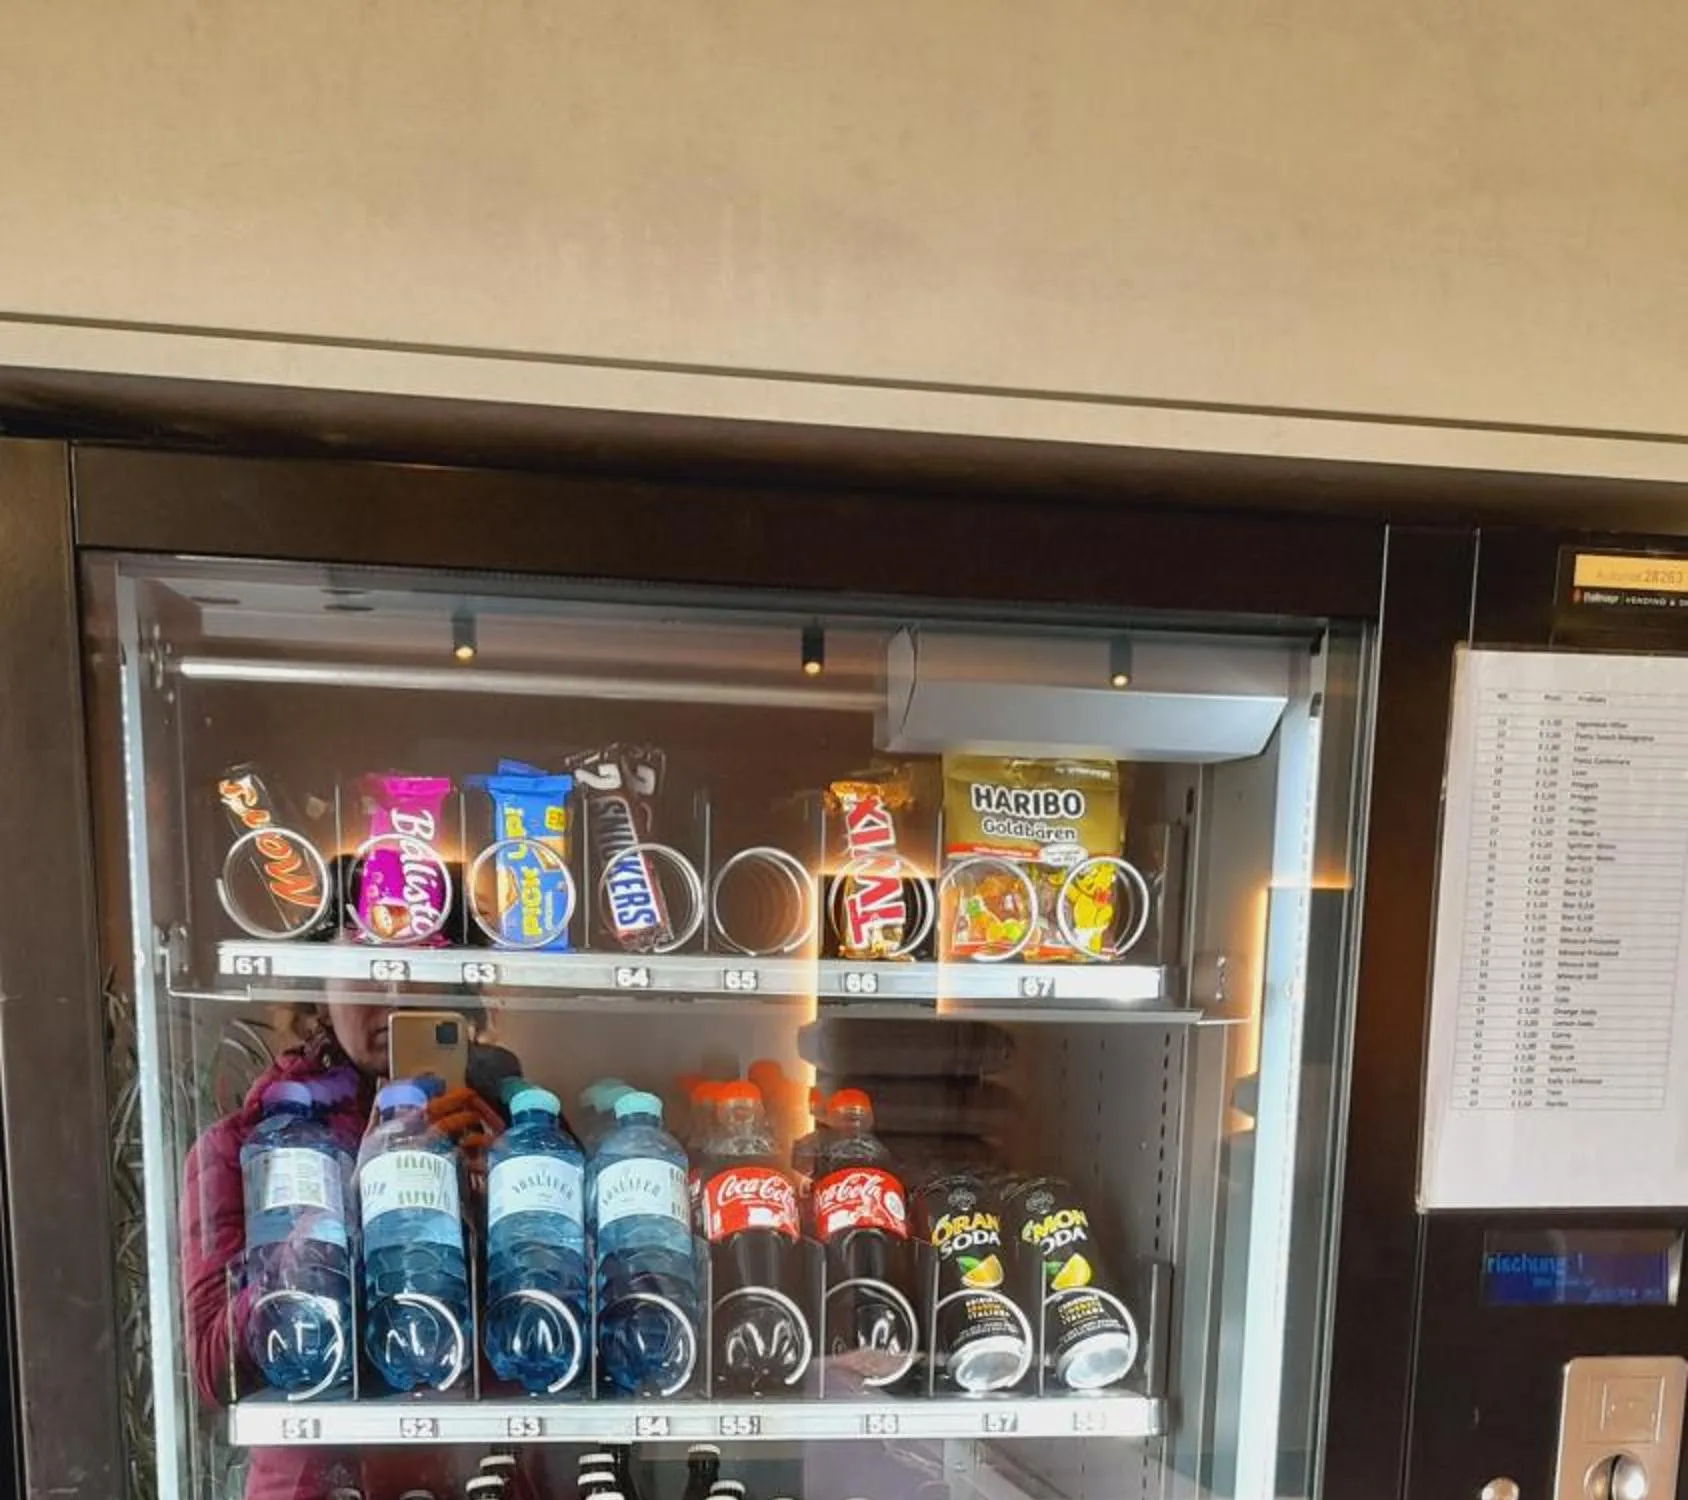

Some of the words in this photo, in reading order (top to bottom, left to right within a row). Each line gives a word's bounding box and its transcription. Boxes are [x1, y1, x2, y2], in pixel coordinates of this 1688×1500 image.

[970, 783, 1086, 819] HARIBO
[847, 793, 906, 948] TWIX
[520, 865, 543, 936] PICK
[235, 957, 267, 976] 61
[372, 961, 408, 981] 62
[463, 963, 497, 983] 63
[617, 969, 650, 989] 64
[725, 970, 757, 990] 65
[846, 973, 878, 993] 66
[1022, 977, 1054, 998] 67
[939, 1229, 1001, 1260] SODA
[1040, 1226, 1088, 1256] ODA
[284, 1418, 316, 1439] 51
[401, 1418, 435, 1438] 52
[508, 1417, 541, 1436] 53
[637, 1416, 669, 1436] 54
[985, 1413, 1017, 1432] 57
